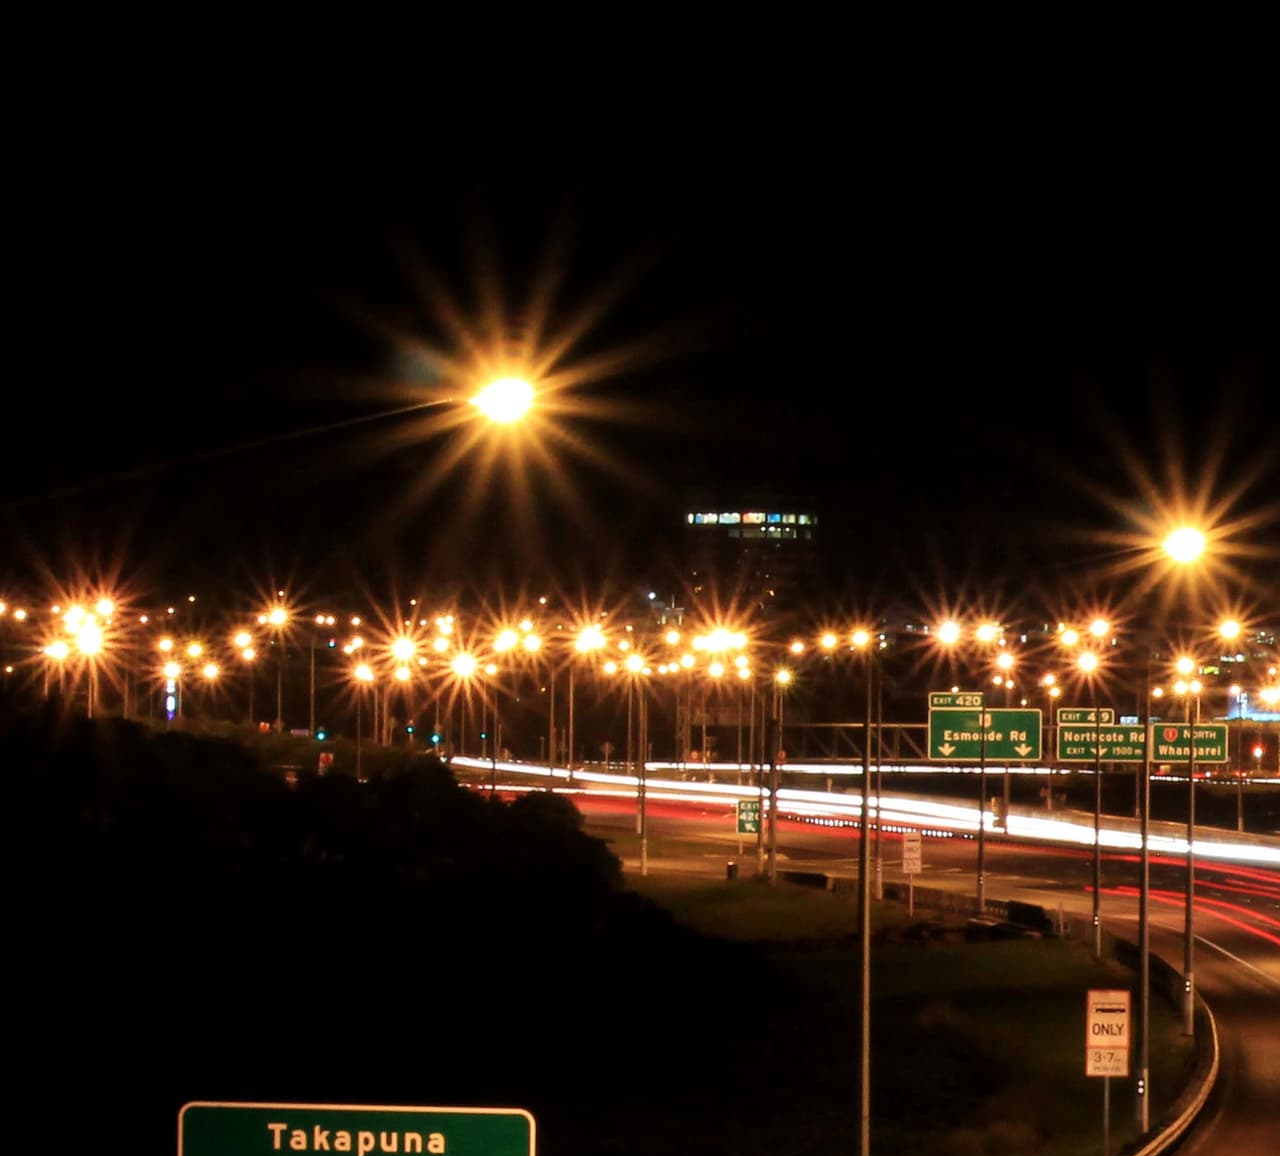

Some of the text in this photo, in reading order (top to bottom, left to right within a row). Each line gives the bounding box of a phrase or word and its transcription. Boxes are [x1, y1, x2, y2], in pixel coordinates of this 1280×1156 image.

[933, 695, 981, 706] EXIT 420
[1062, 711, 1110, 722] EXIT 49
[1009, 730, 1027, 742] Rd
[1129, 732, 1145, 743] Rd
[1066, 747, 1085, 755] EXIT
[1092, 1023, 1125, 1036] ONLY
